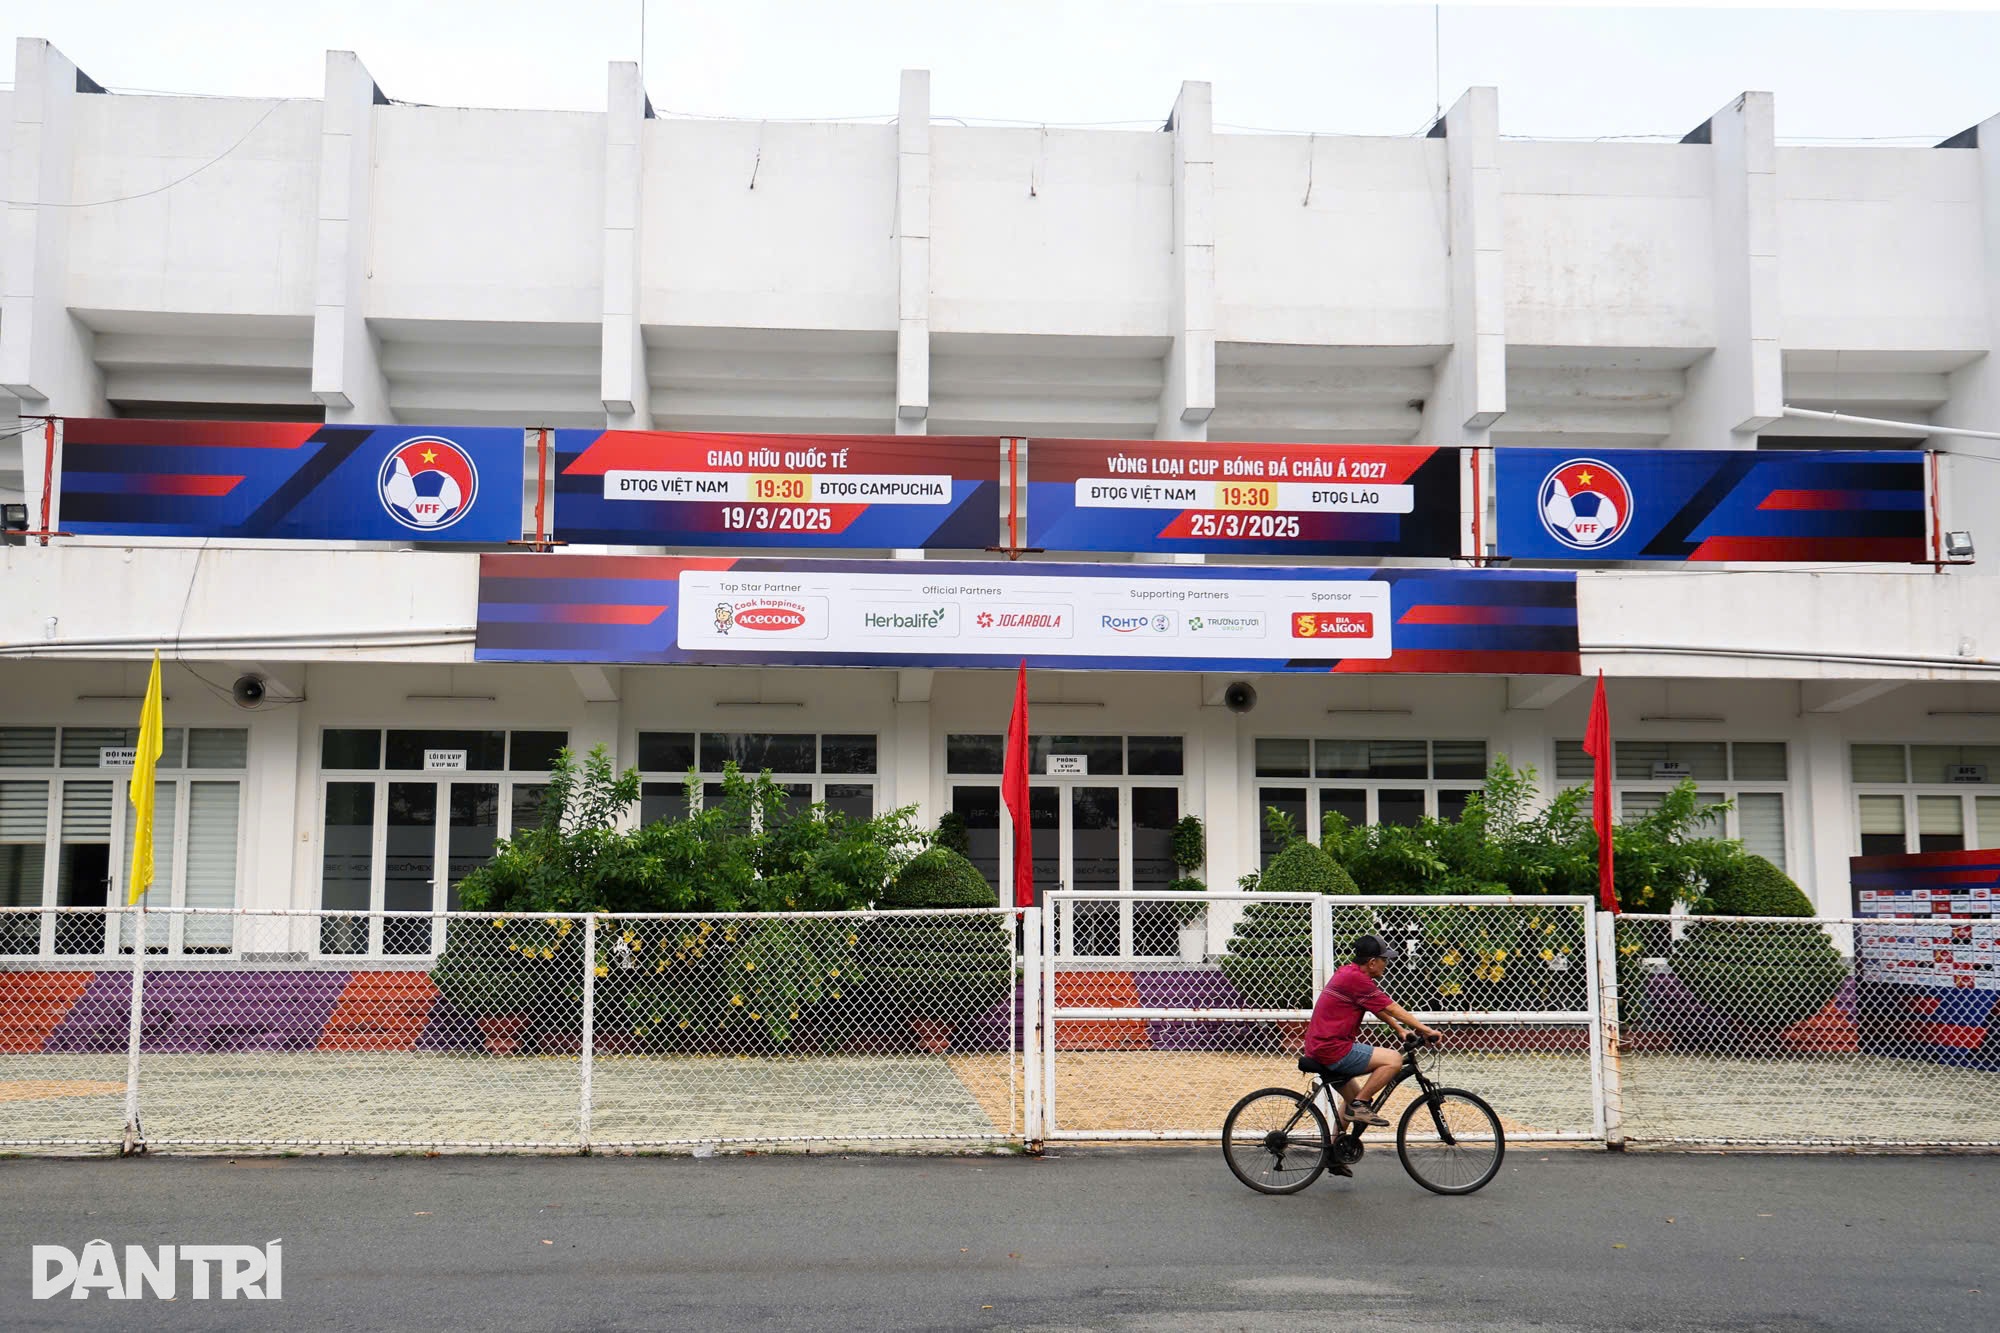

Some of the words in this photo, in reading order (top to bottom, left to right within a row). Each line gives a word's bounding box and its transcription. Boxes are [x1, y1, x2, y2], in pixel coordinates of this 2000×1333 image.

[707, 450, 743, 467] GIAO
[748, 447, 780, 468] HỮU
[784, 447, 827, 470] QUỐC
[831, 447, 849, 468] TẾ
[1107, 453, 1147, 474] VÒNG
[1152, 458, 1184, 478] LOẠI
[1188, 459, 1219, 475] CUP
[1223, 456, 1264, 476] BÓNG
[1268, 457, 1288, 476] ĐÁ
[1292, 457, 1333, 477] CHÂU
[1337, 458, 1347, 477] Á
[1351, 462, 1387, 478] 2027
[620, 479, 658, 493] ĐTQG
[661, 477, 693, 496] VIỆT
[696, 481, 728, 493] NAM
[755, 479, 804, 498] 19:30
[820, 482, 857, 496] ĐTQG
[860, 482, 944, 496] CAMPUCHIA
[1091, 486, 1128, 501] ĐTQG
[1131, 485, 1161, 503] VIỆT
[1165, 488, 1196, 501] NAM
[1222, 487, 1270, 506] 19:30
[1312, 491, 1348, 504] ĐTQG
[1351, 489, 1379, 504] LÀO
[415, 503, 440, 514] VFF
[721, 506, 832, 530] 19/3/2025
[1191, 514, 1300, 538] 25/3/2025
[1575, 523, 1598, 533] VFF
[720, 583, 739, 593] Top
[741, 583, 761, 592] Star
[764, 584, 801, 592] Partner
[922, 586, 957, 595] Official
[960, 586, 1002, 596] Partners
[1130, 589, 1185, 600] Supporting
[1188, 590, 1229, 600] Partners
[1311, 592, 1352, 602] Sponsor
[734, 599, 757, 610] Cook
[760, 598, 805, 612] happiness
[865, 612, 938, 629] Herbalife
[996, 614, 1061, 628] JOGARBOLA
[1321, 624, 1366, 632] SAIGON
